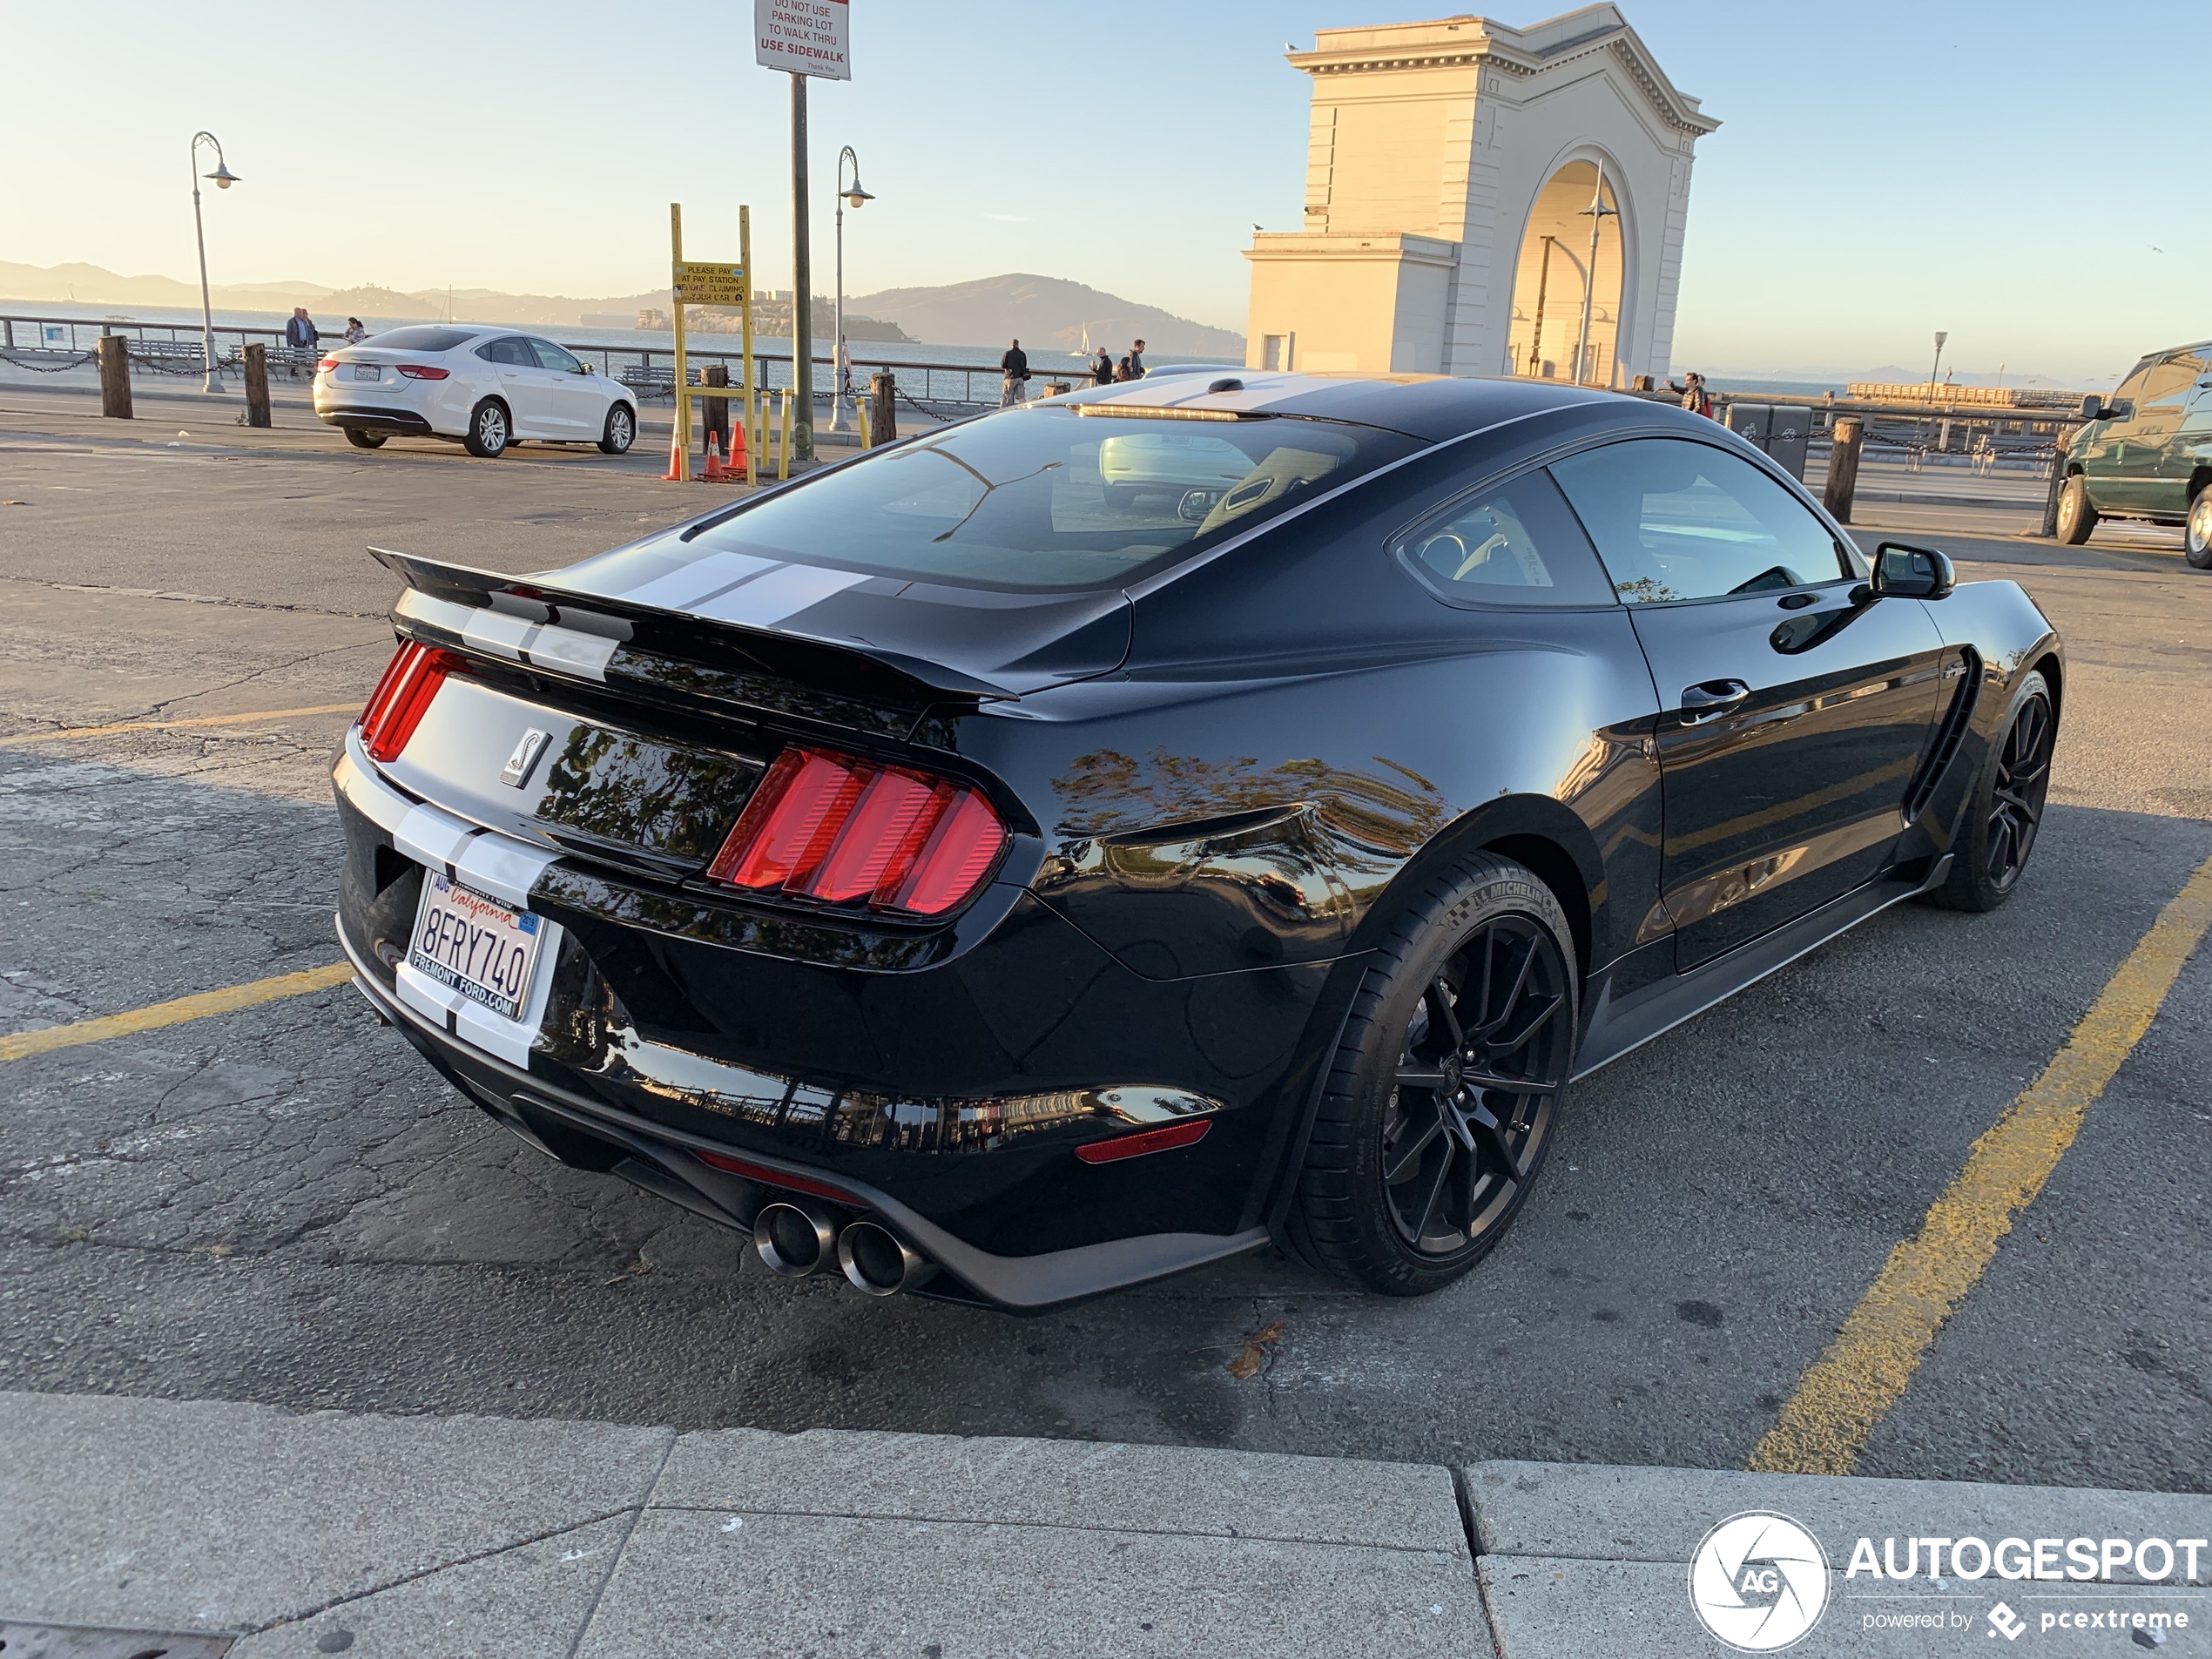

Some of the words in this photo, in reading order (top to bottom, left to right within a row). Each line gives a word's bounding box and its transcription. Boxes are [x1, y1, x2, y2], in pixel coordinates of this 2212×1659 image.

[791, 1, 810, 12] NOT
[813, 4, 831, 17] USE
[772, 10, 813, 27] PARKING
[815, 19, 833, 31] LOT
[768, 23, 781, 35] TO
[784, 26, 811, 40] WALK
[813, 32, 837, 45] THRU
[761, 38, 784, 51] USE
[787, 43, 845, 63] SIDEWALK
[807, 62, 824, 71] Thank
[687, 266, 716, 274] PLEASE
[435, 875, 449, 894] AUG
[1490, 882, 1544, 905] MICHELIN
[450, 887, 520, 930] California
[522, 914, 536, 928] 2019
[422, 905, 526, 997] 8FRY740
[413, 953, 458, 985] FREMONT
[458, 978, 513, 1016] FORD.COM
